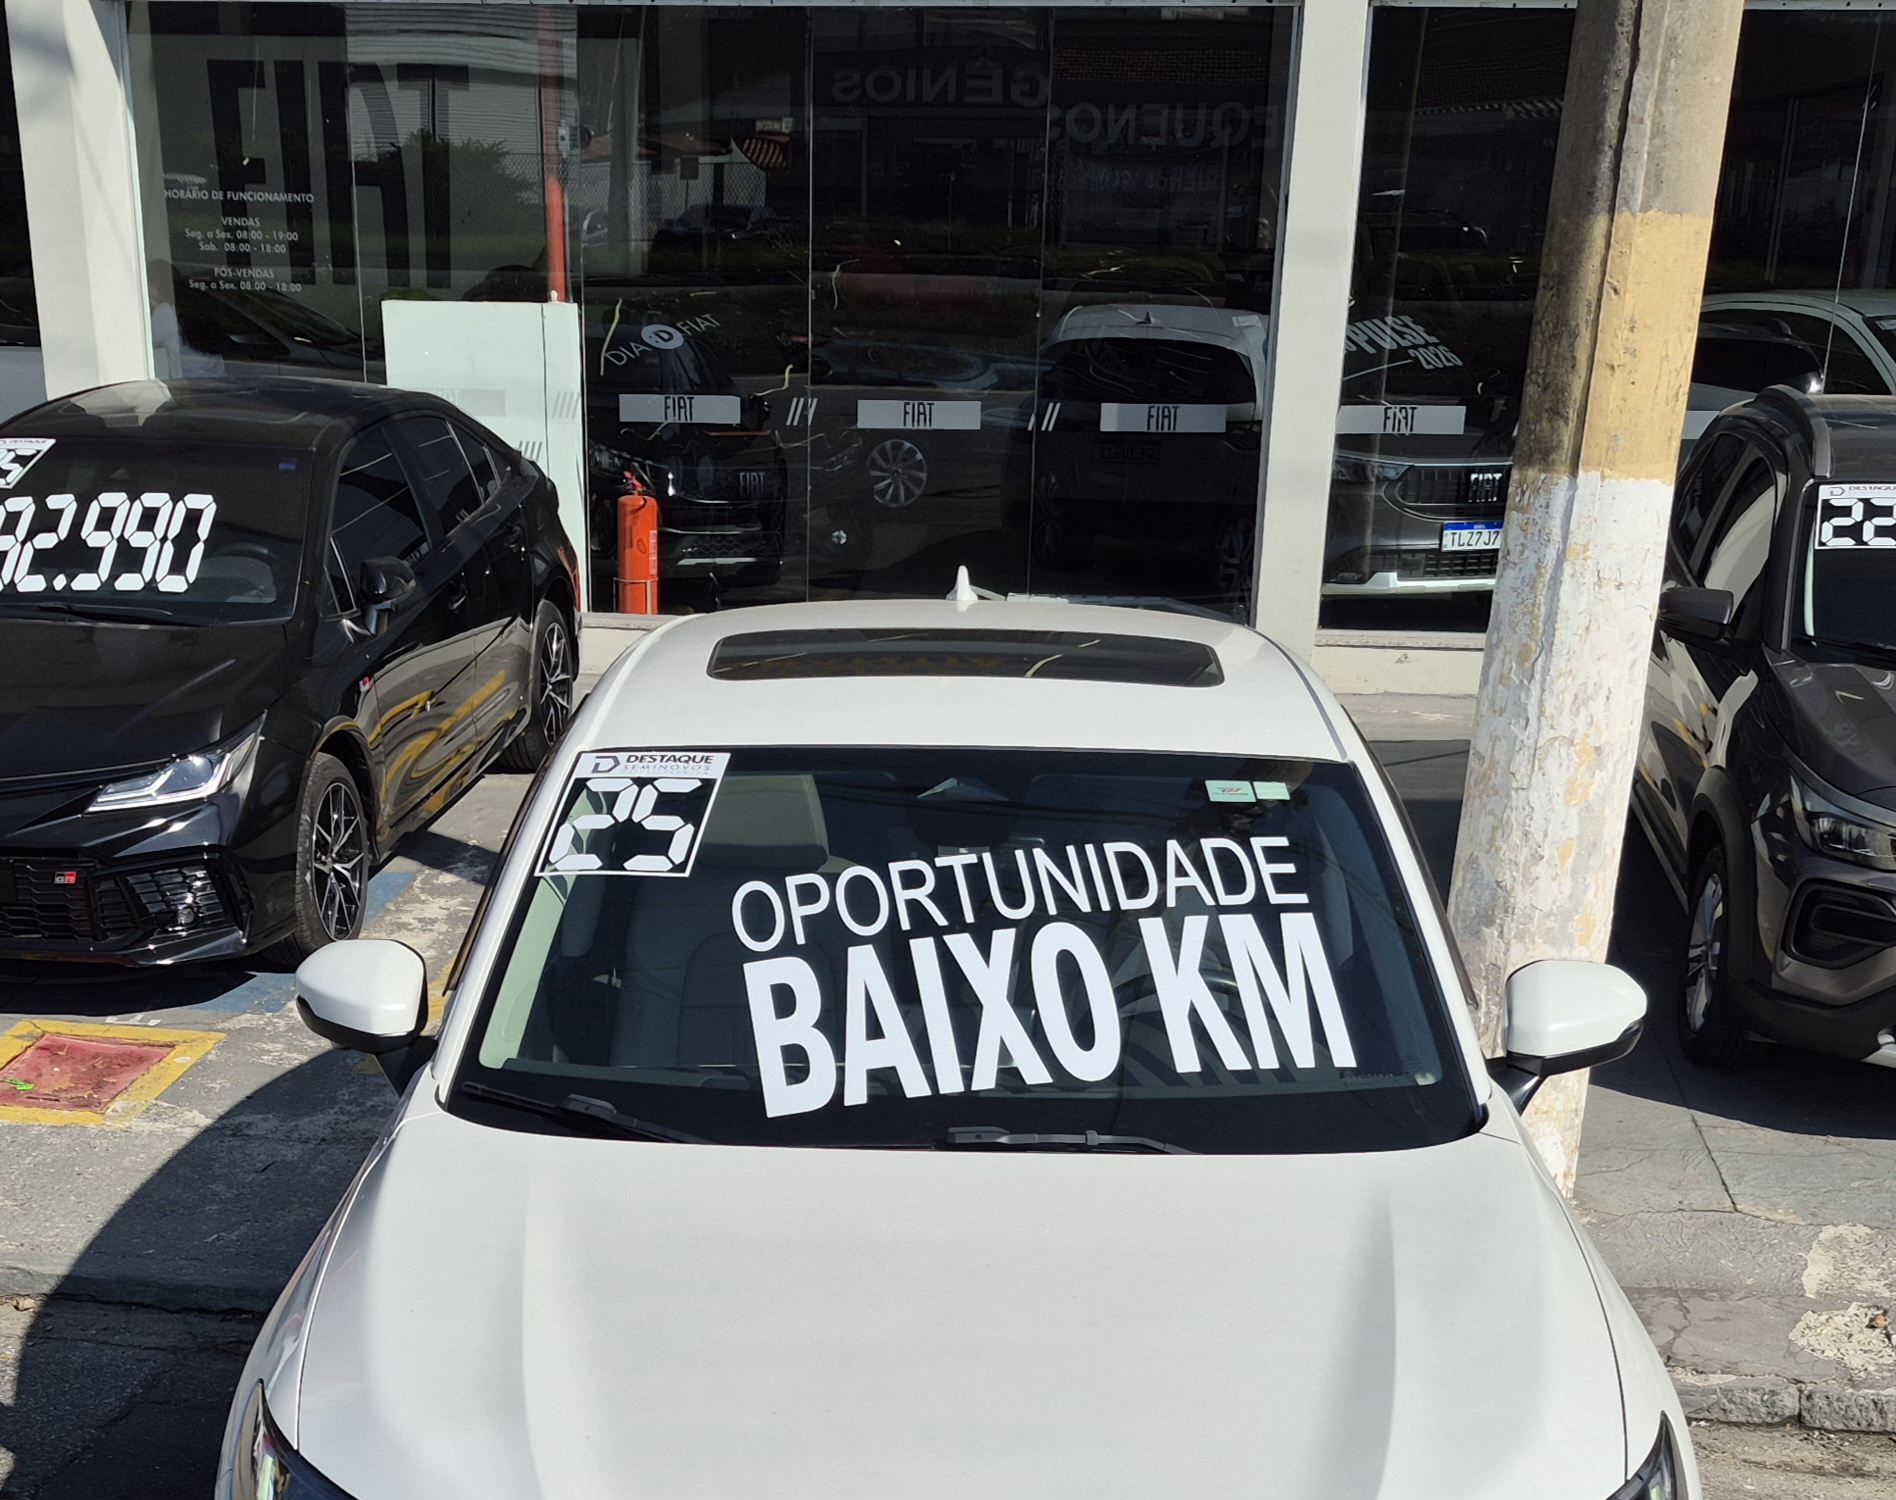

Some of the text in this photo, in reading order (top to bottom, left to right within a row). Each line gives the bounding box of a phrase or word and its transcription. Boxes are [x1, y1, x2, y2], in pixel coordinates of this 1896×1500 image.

[206, 59, 470, 289] FIAT
[211, 190, 224, 200] DE
[226, 190, 314, 203] FUNCIONAMENTO
[185, 228, 205, 240] Seg.
[235, 230, 263, 240] 08:00
[272, 231, 299, 241] 19:00
[221, 216, 260, 227] VENDAS
[199, 241, 218, 251] Sab.
[224, 242, 251, 252] 08:00
[260, 243, 287, 254] 18:00
[188, 279, 208, 291] Seg.
[276, 281, 302, 292] 18:00
[214, 265, 275, 279] PÓS-VENDAS
[605, 341, 652, 366] DIA
[676, 313, 721, 336] FIAT
[1346, 315, 1441, 355] PULSE
[1408, 345, 1464, 370] 2026
[664, 395, 695, 422] FIAT
[903, 400, 935, 428] FIAT
[1146, 404, 1180, 432] FIAT
[1383, 406, 1418, 433] FIAT
[739, 471, 766, 495] FIAT
[1468, 472, 1503, 502] FIAT
[626, 754, 714, 765] DESTAQUE
[549, 778, 703, 872] 25
[731, 836, 1310, 952] OPORTUNIDADE
[742, 912, 1358, 1119] BAIXO KM
